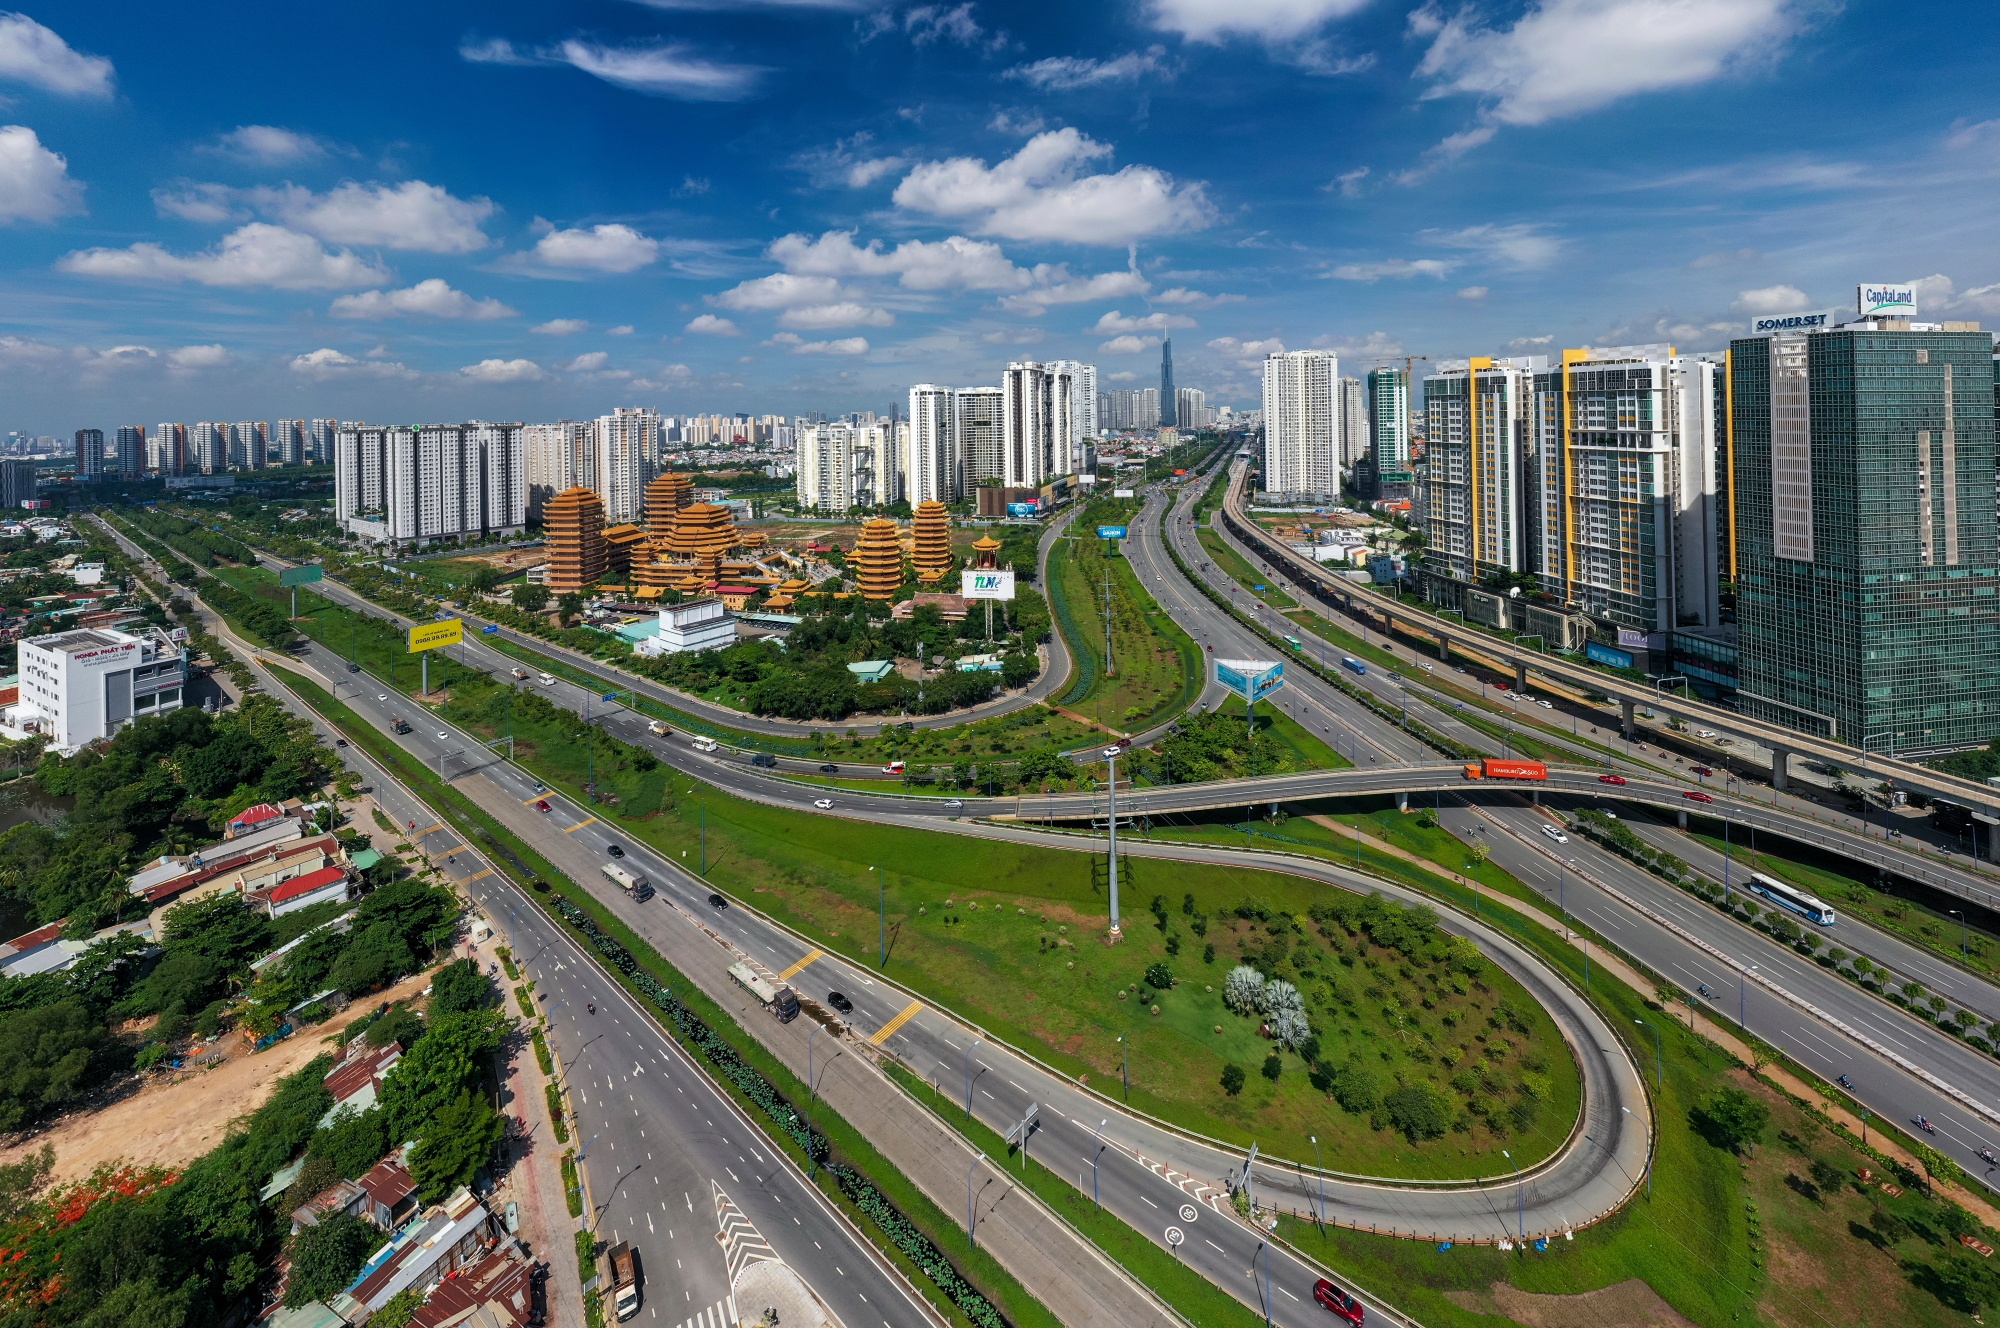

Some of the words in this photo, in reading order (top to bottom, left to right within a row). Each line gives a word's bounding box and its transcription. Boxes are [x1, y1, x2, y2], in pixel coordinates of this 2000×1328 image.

[1866, 287, 1912, 306] CapitaLand
[1757, 314, 1827, 330] SOMERSET
[74, 651, 99, 660] HONDA
[100, 647, 119, 655] PHÁT
[1183, 1208, 1194, 1219] 50
